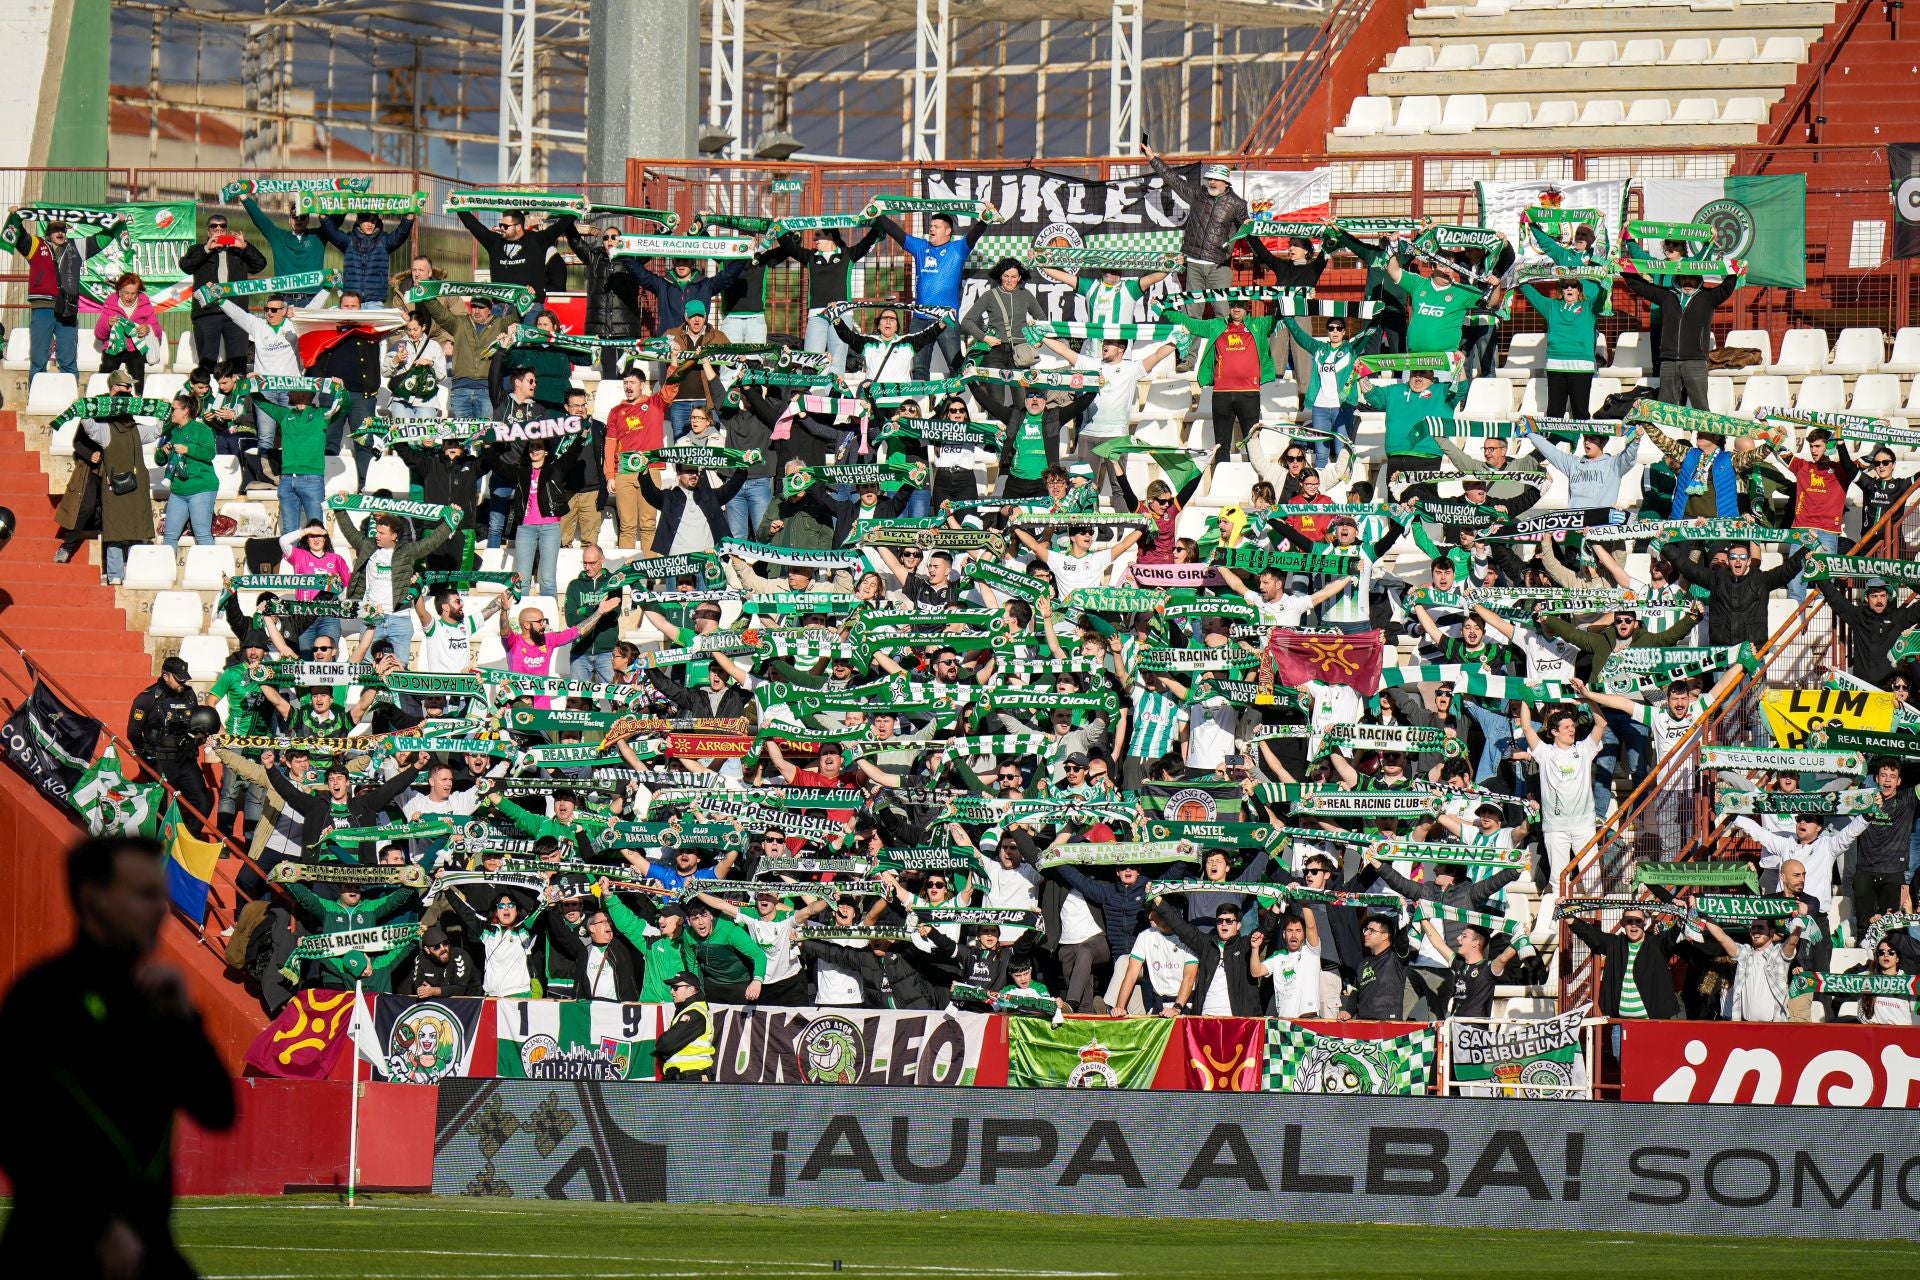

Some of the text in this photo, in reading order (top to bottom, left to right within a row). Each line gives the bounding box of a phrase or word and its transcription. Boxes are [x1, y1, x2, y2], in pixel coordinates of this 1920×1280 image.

[259, 179, 330, 191] SANTANDER
[774, 182, 801, 191] SALIDA
[321, 199, 410, 211] REAL RACING CLUB
[498, 198, 536, 207] RACING
[885, 201, 976, 211] REAL RACING CLUB
[785, 218, 816, 228] RACING
[638, 238, 726, 250] REAL RACING CLUB
[237, 272, 320, 294] RACING SANTANDER
[1418, 302, 1444, 317] Teka
[269, 376, 313, 389] RACING
[495, 416, 581, 441] RACING
[910, 420, 966, 433] UNA ILUSIÓN
[922, 430, 984, 443] NOS PERSIGUE
[1842, 430, 1888, 441] COMUNIDAD
[659, 447, 713, 457] UNA ILUSIÓN
[687, 456, 728, 467] PERSIGUE
[824, 464, 880, 476] UNA ILUSIÓN
[835, 473, 896, 484] NOS PERSIGUE
[1286, 504, 1374, 513] RACING SANTANDER
[1425, 503, 1476, 517] UNA ILUSIÓN
[1435, 513, 1491, 525] NOS PERSIGUE
[1517, 514, 1584, 533] RACING
[1589, 523, 1658, 536] REAL RACING
[1686, 528, 1784, 539] RACING SANTANDER
[633, 555, 687, 571] UNA ILUSIÓN
[1826, 557, 1901, 577] REAL RACING
[647, 568, 664, 578] NOS
[1177, 568, 1216, 579] GIRLS
[242, 575, 315, 587] SANTANDER
[782, 593, 829, 604] RACING
[1152, 650, 1247, 661] REAL RACING CLUB
[282, 663, 372, 676] REAL RACING CLUB
[1536, 659, 1562, 671] Teka
[513, 679, 637, 698] REAL RACING CLUB
[1218, 681, 1238, 692] UNA
[994, 695, 1056, 705] SOTILEZA
[1231, 690, 1249, 702] NOS
[548, 711, 592, 720] AMSTEL
[1331, 727, 1435, 742] REAL RACING CLUB
[399, 737, 490, 752] RACING SANTANDER
[1838, 735, 1905, 748] REAL RACING
[542, 750, 569, 761] REAL
[1727, 753, 1825, 766] REAL RACING CLUB
[1167, 790, 1198, 811] RACING
[1200, 792, 1215, 812] CLUB
[1326, 799, 1419, 809] REAL RACING CLUB
[1779, 800, 1833, 812] RACING
[1183, 824, 1225, 836] AMSTEL
[1218, 835, 1238, 843] Racing
[889, 850, 949, 862] UNA ILUSIÓN
[1405, 843, 1494, 861] RACING
[904, 859, 968, 869] NOS PERSIGUE
[1731, 899, 1793, 914] RACING
[932, 910, 1025, 921] REAL RACING CLUB
[307, 926, 408, 951] REAL RACING CLUB
[1825, 975, 1906, 991] SANTANDER
[769, 1113, 1584, 1200] ¡AUPA ALBA!
